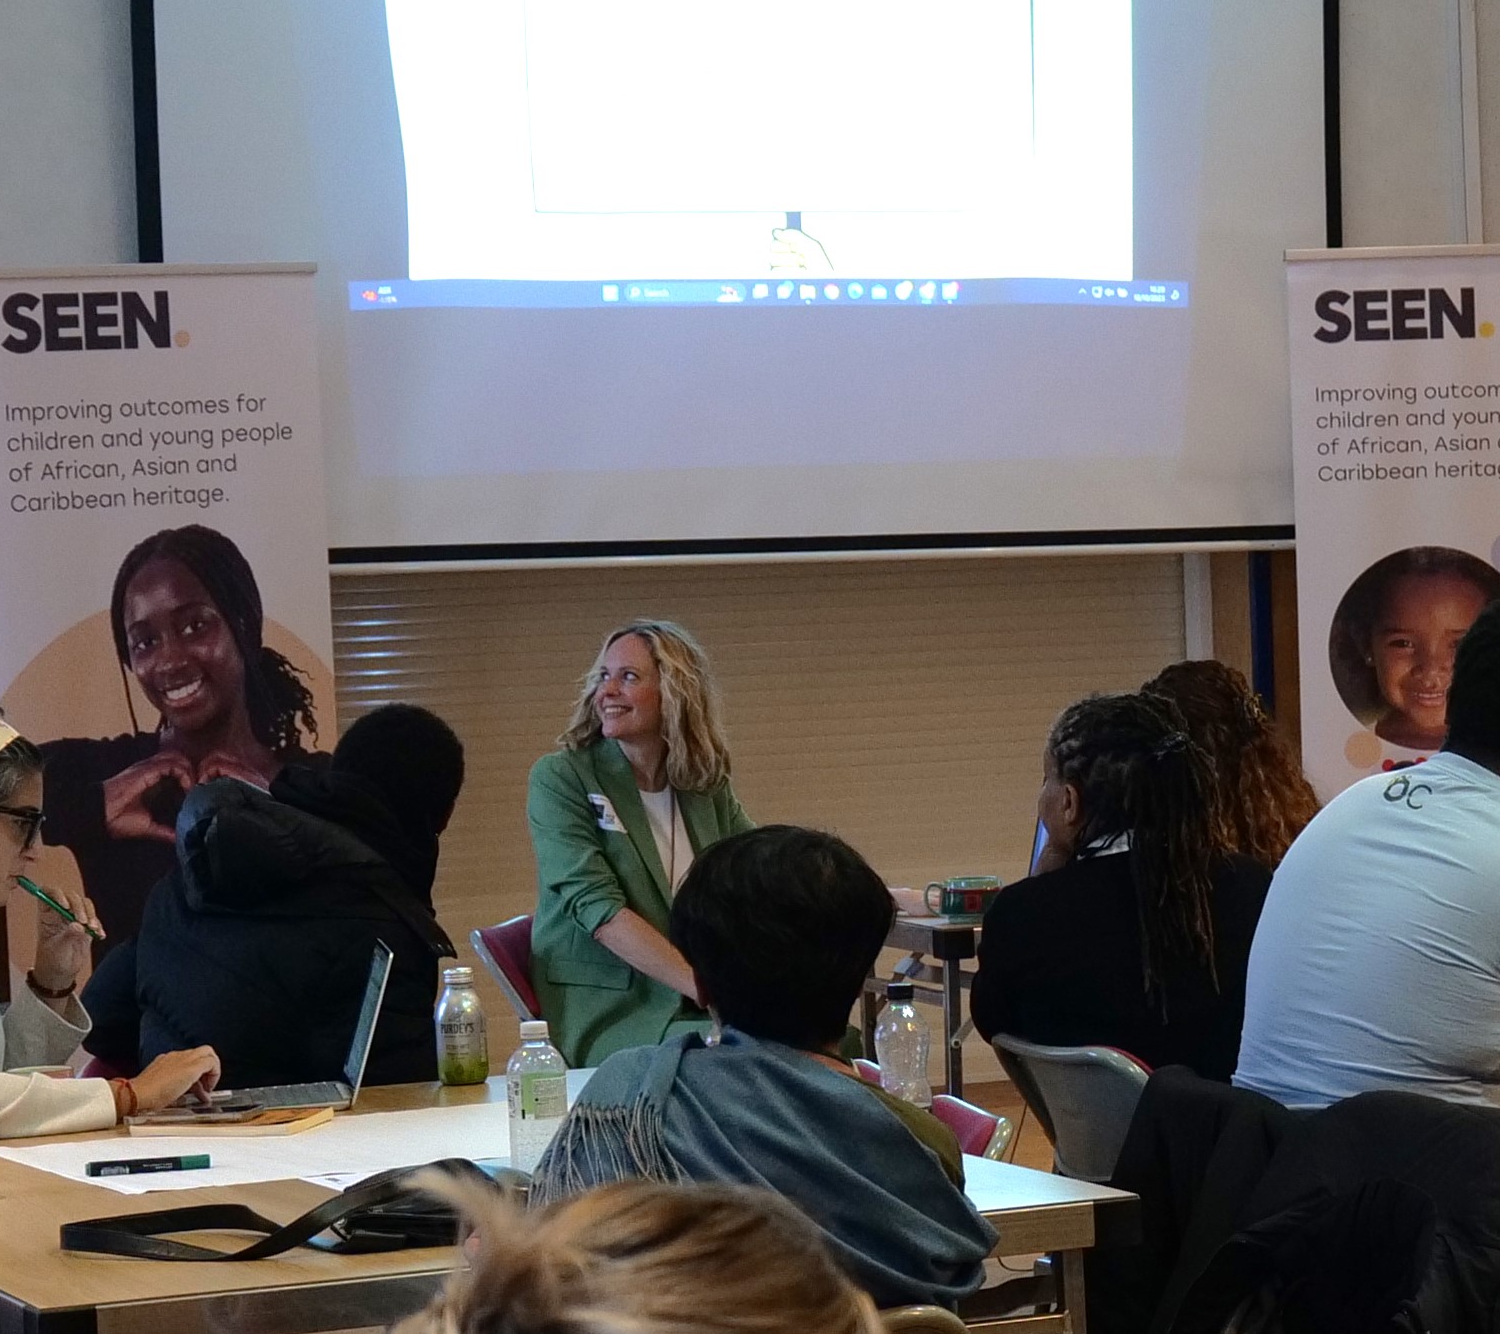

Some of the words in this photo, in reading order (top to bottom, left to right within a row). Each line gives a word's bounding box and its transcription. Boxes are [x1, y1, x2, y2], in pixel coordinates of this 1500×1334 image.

[1315, 382, 1417, 406] Improving
[5, 399, 112, 426] Improving
[119, 398, 230, 418] outcomes
[236, 393, 267, 413] for
[1315, 411, 1399, 430] children
[1405, 408, 1445, 427] and
[6, 431, 94, 453] children
[101, 428, 143, 447] and
[149, 428, 214, 451] young
[221, 422, 294, 447] people
[1317, 437, 1340, 456] of
[1346, 435, 1428, 455] African,
[1433, 433, 1491, 452] Asian
[8, 462, 33, 482] of
[40, 459, 126, 481] African,
[132, 456, 190, 476] Asian
[195, 453, 237, 473] and
[1317, 463, 1428, 483] Caribbean
[10, 490, 126, 513] Caribbean
[132, 485, 230, 508] heritage.
